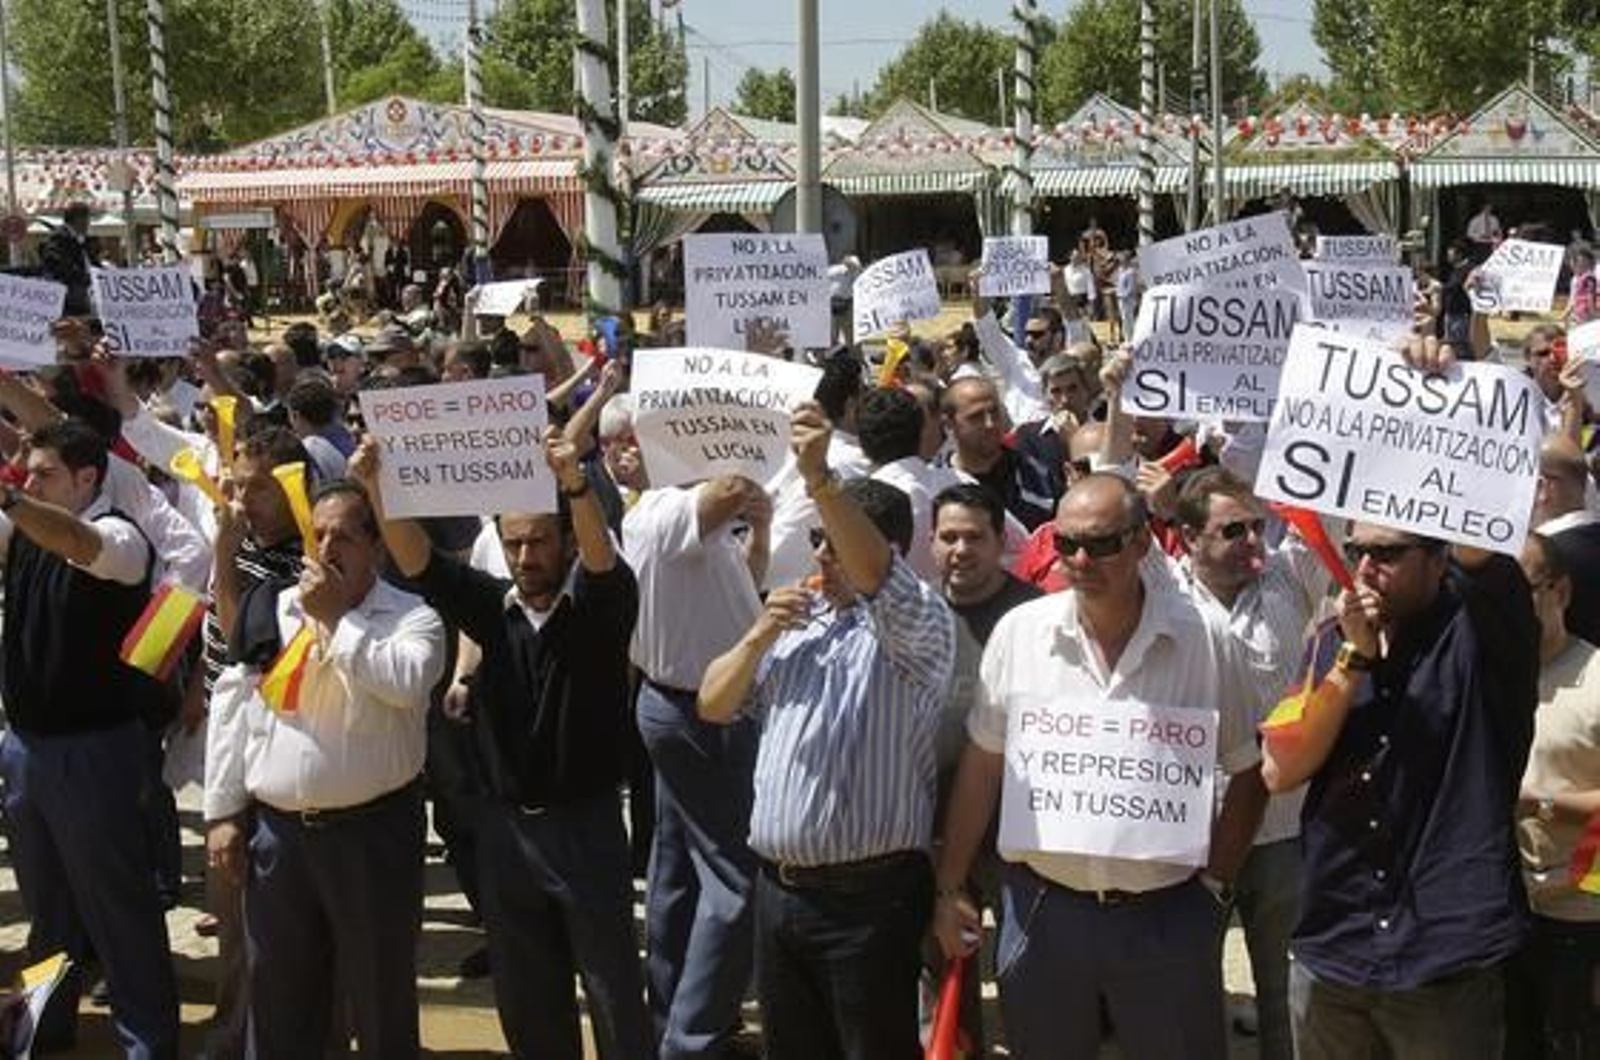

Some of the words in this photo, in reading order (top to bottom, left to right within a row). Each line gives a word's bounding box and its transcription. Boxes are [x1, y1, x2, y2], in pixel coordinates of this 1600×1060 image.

[731, 239, 755, 254] NO
[761, 240, 771, 253] A
[774, 240, 797, 254] LA
[1185, 235, 1211, 254] NO
[1218, 233, 1231, 247] A
[1234, 224, 1257, 243] LA
[1325, 238, 1391, 257] TUSSAM
[97, 272, 183, 302] TUSSAM
[714, 291, 785, 310] TUSSAM
[789, 290, 809, 306] EN
[1307, 270, 1406, 303] TUSSAM
[1152, 295, 1298, 340] TUSSAM
[104, 322, 132, 352] SI
[1154, 341, 1167, 362] A
[1170, 341, 1189, 363] LA
[683, 355, 714, 375] NO
[718, 357, 733, 375] A
[741, 361, 769, 379] LA
[1133, 369, 1187, 412] SI
[1233, 373, 1266, 393] AL
[1317, 342, 1530, 436] TUSSAM
[372, 399, 438, 425] PSOE
[444, 401, 460, 413] =
[467, 390, 538, 416] PARO
[1196, 396, 1278, 418] EMPLE
[384, 437, 397, 454] Y
[404, 426, 542, 453] REPRESION
[666, 415, 748, 438] TUSSAM
[752, 418, 779, 436] EN
[1281, 395, 1315, 429] NO
[1316, 405, 1332, 434] A
[1337, 407, 1364, 440] LA
[1367, 413, 1537, 477] PRIVATIZACIÓN
[701, 443, 767, 464] LUCHA
[398, 466, 432, 487] EN
[436, 460, 535, 485] TUSSAM
[1276, 440, 1356, 508] SI
[1421, 466, 1464, 497] AL
[1361, 489, 1515, 543] EMPLEO
[1020, 709, 1095, 738] PSOE
[1103, 720, 1120, 733] =
[1129, 718, 1208, 749] PARO
[1018, 751, 1034, 768] Y
[1041, 751, 1204, 789] REPRESION
[1029, 788, 1063, 812] EN
[1073, 790, 1186, 823] TUSSAM
